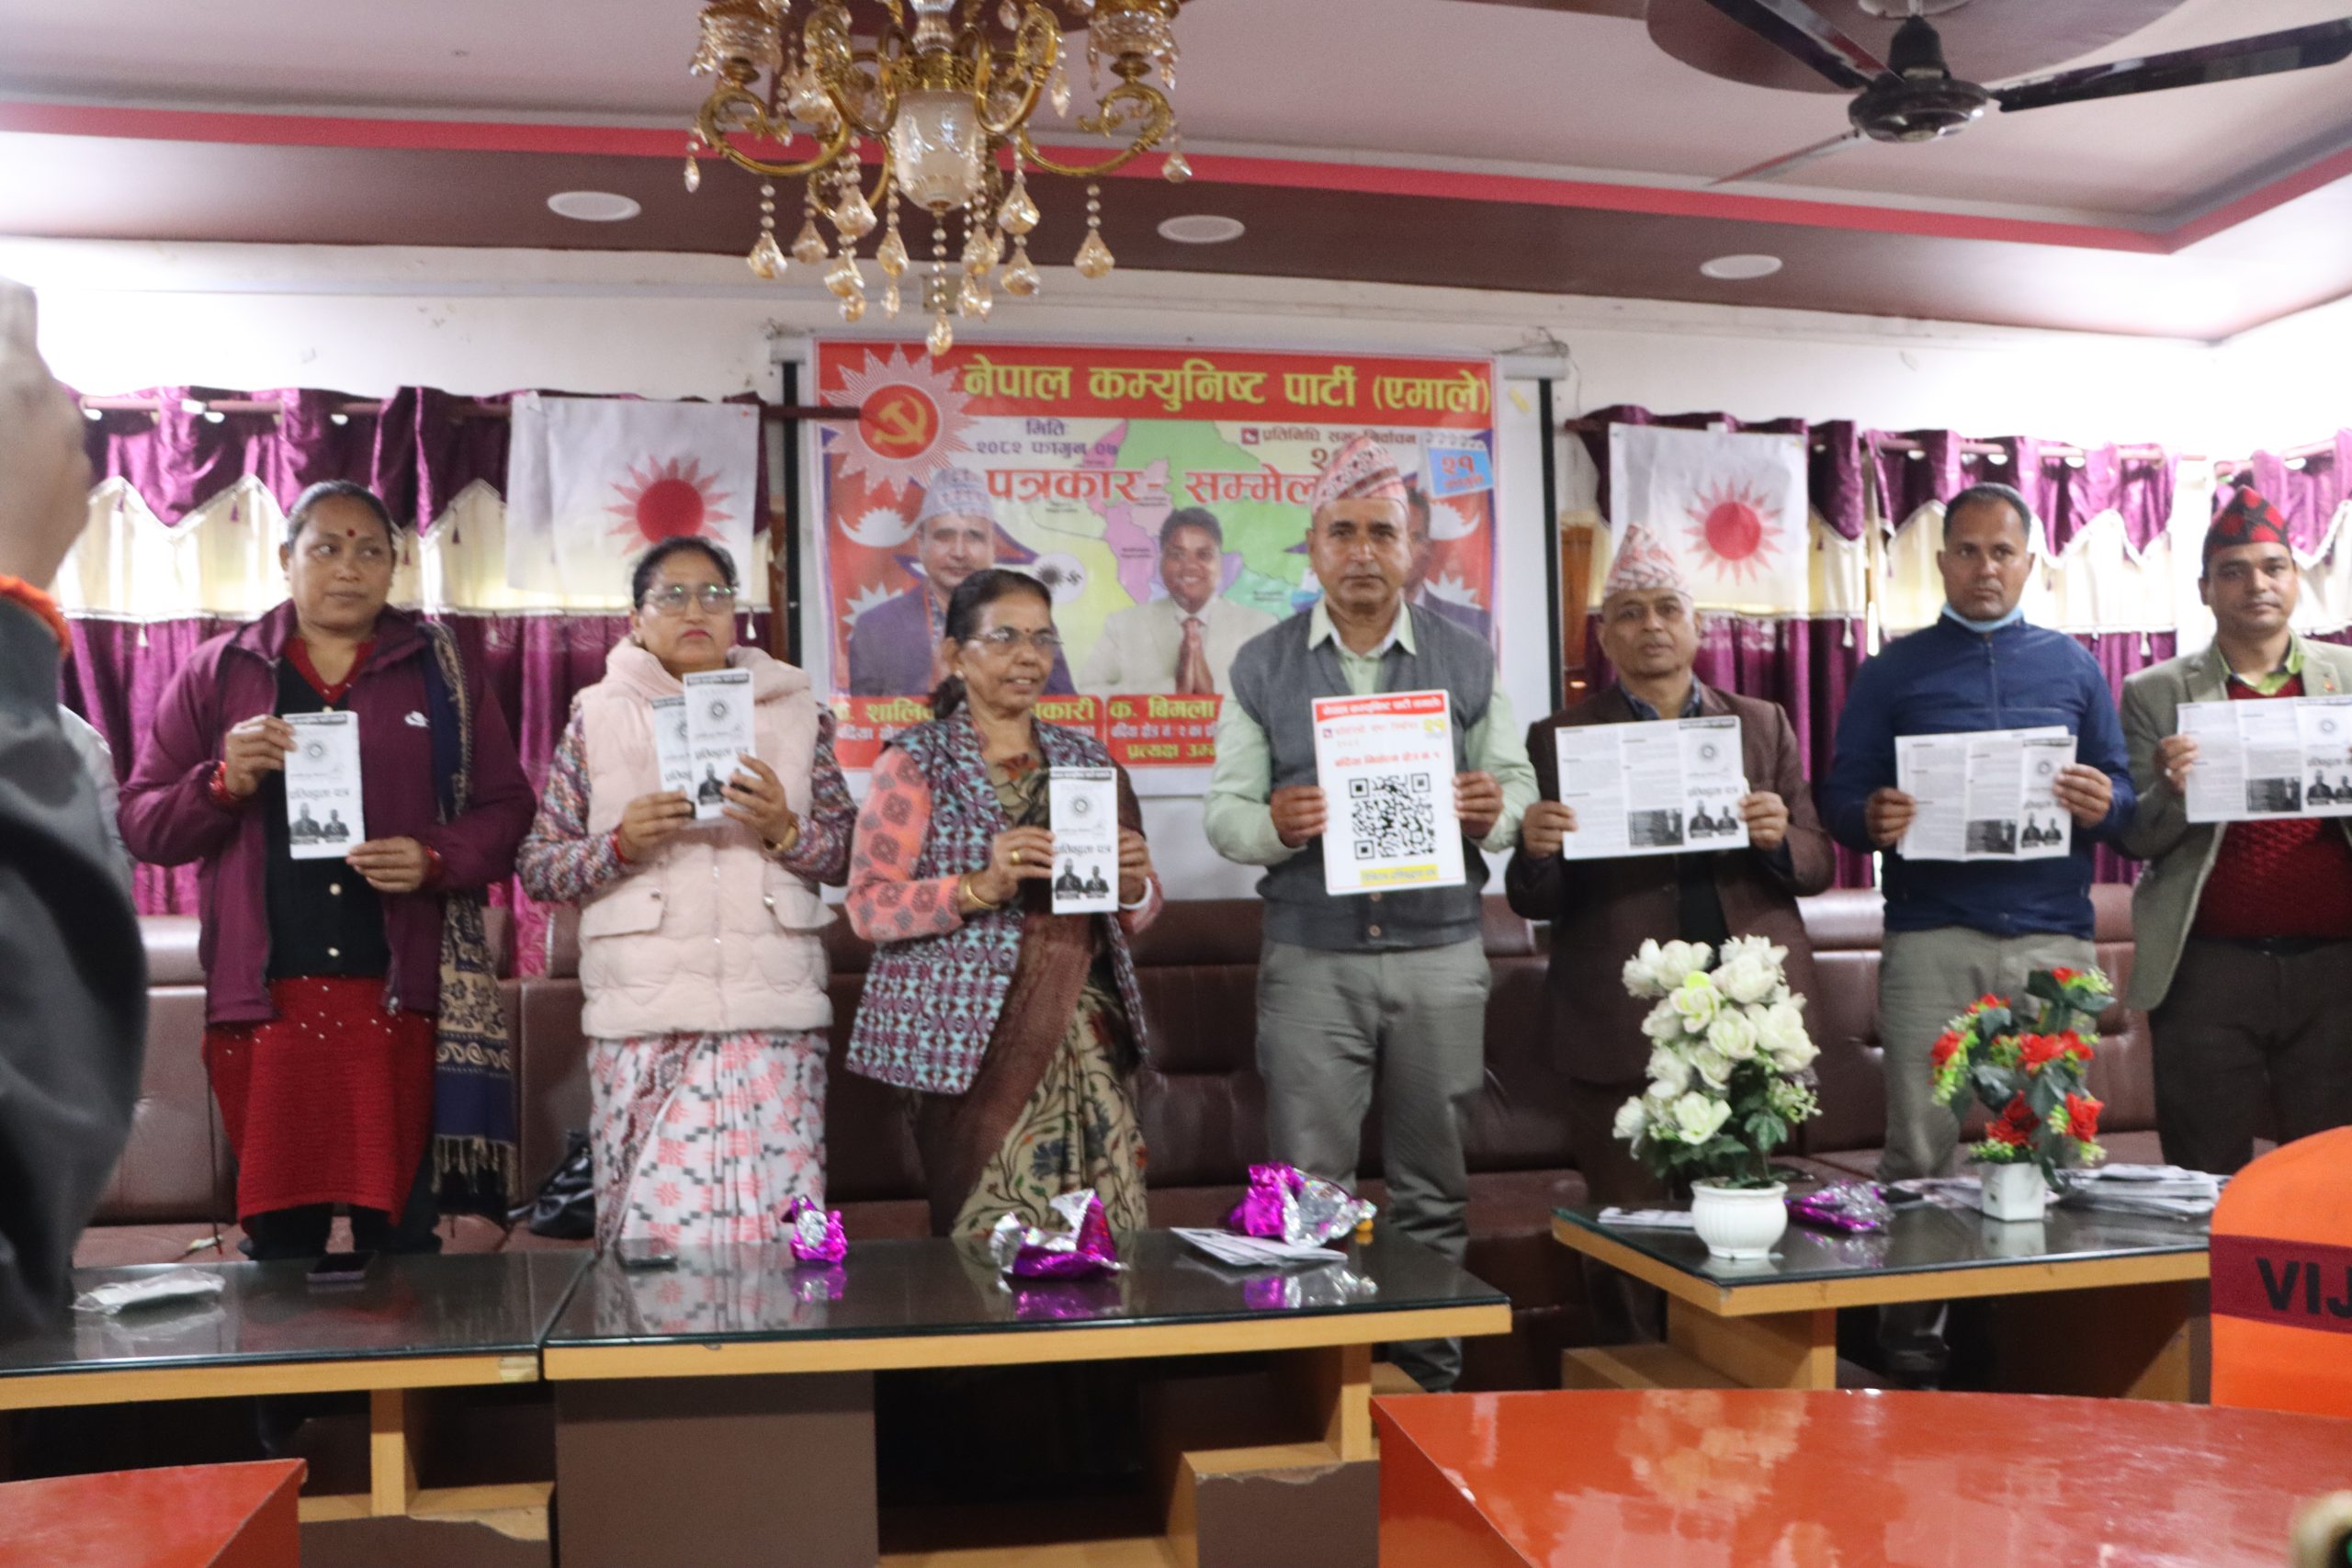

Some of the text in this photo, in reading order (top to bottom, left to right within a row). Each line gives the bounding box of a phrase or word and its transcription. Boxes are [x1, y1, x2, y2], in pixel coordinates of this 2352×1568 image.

[964, 353, 1491, 414] नेपाल कम्युनिष्ट पार्टी (एमाले)
[977, 441, 1022, 455] २०८२
[986, 469, 1144, 502] पत्रकार
[1184, 463, 1316, 504] सम्मेल
[2256, 1257, 2352, 1318] VIJ
